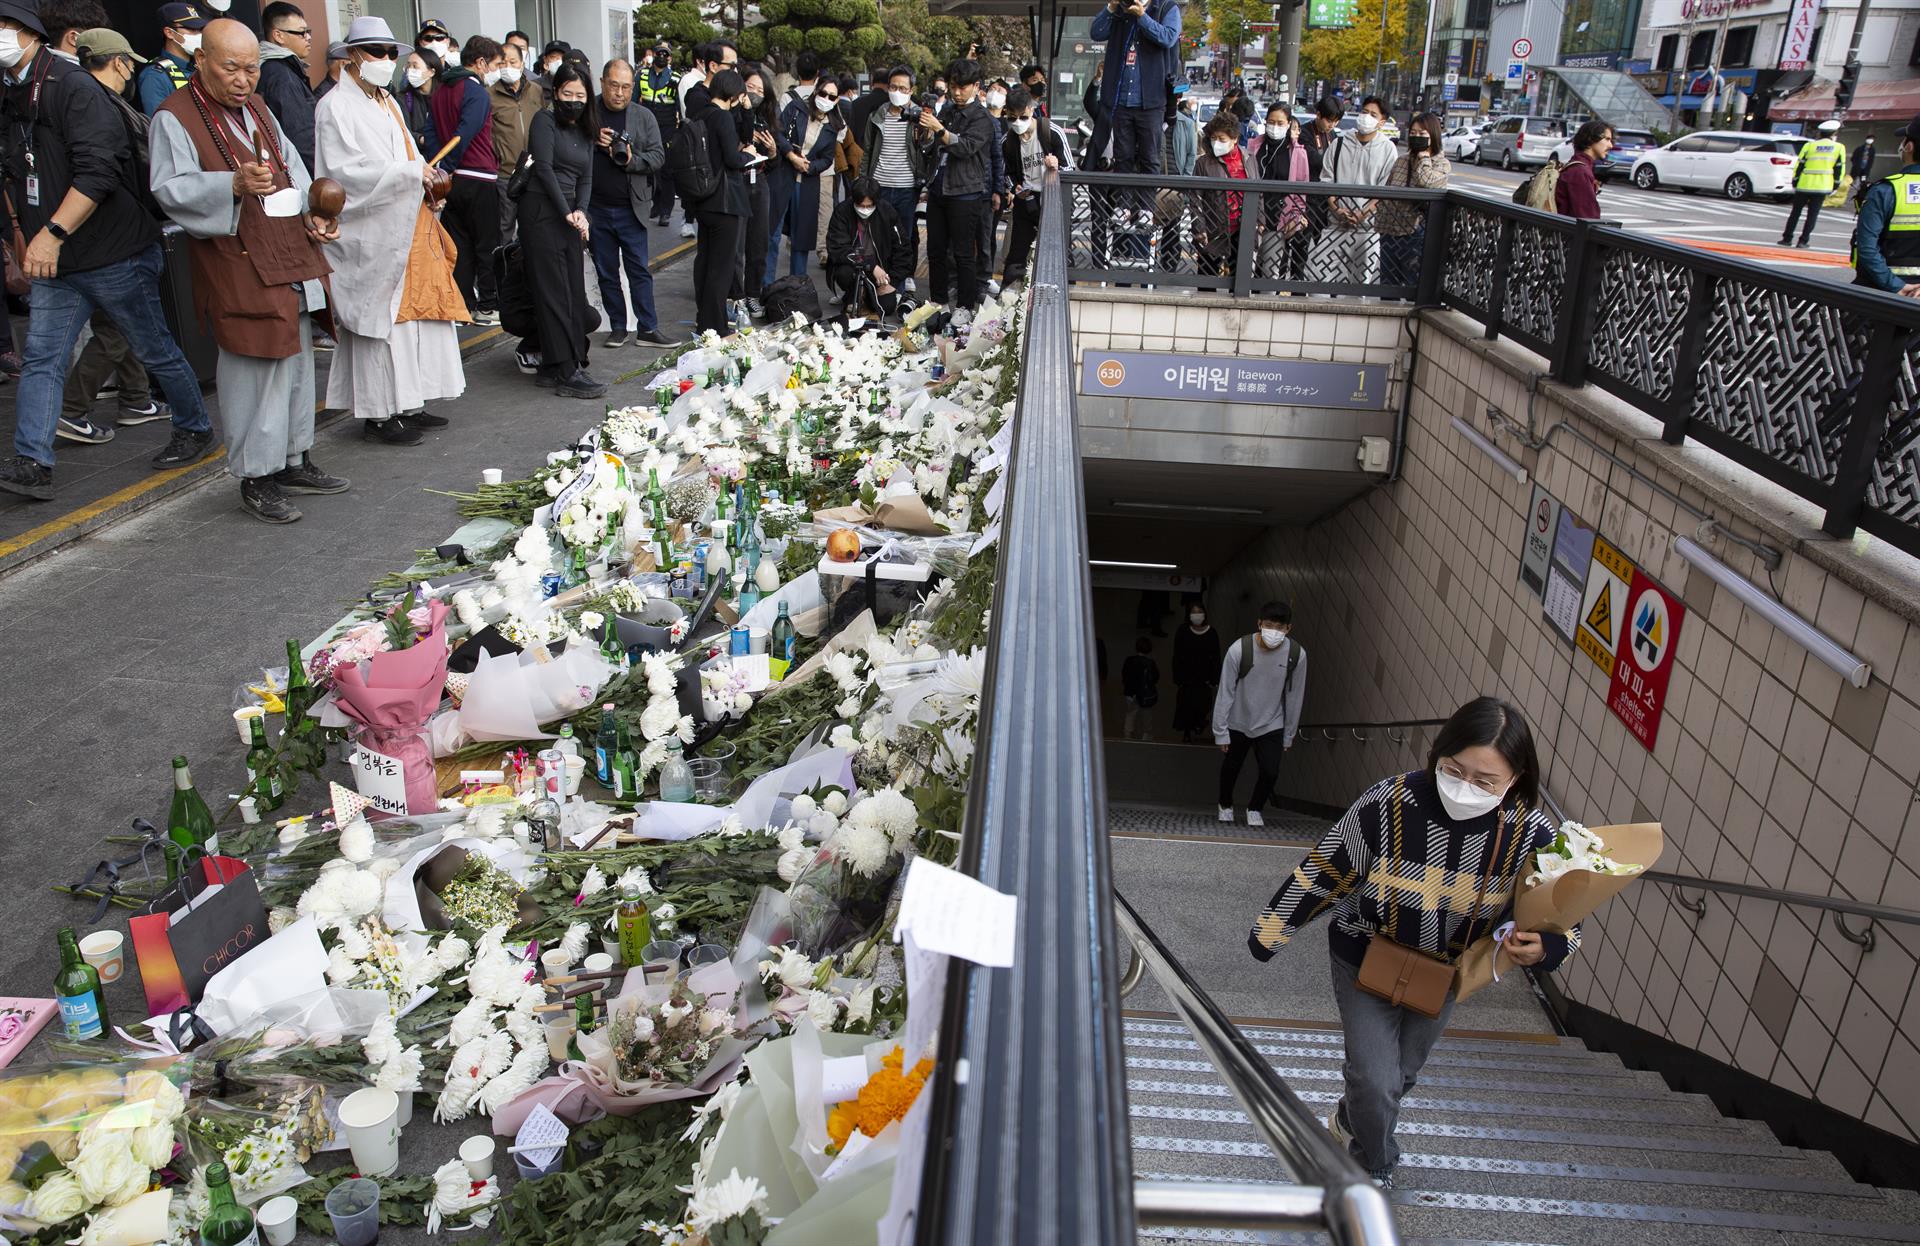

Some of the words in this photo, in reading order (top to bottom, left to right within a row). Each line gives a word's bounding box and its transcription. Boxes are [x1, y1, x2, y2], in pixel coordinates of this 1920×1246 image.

[1516, 43, 1529, 54] 50
[1100, 368, 1121, 379] 630
[1164, 365, 1230, 392] 이태원
[1237, 369, 1282, 381] Itaewon
[1357, 369, 1366, 391] 1
[1236, 382, 1267, 394] 梨泰院
[1275, 384, 1320, 396] イテウォン
[1618, 660, 1656, 711] 대피소
[1620, 691, 1646, 722] shelter
[360, 751, 398, 776] 명복을
[203, 923, 256, 975] CHICOR
